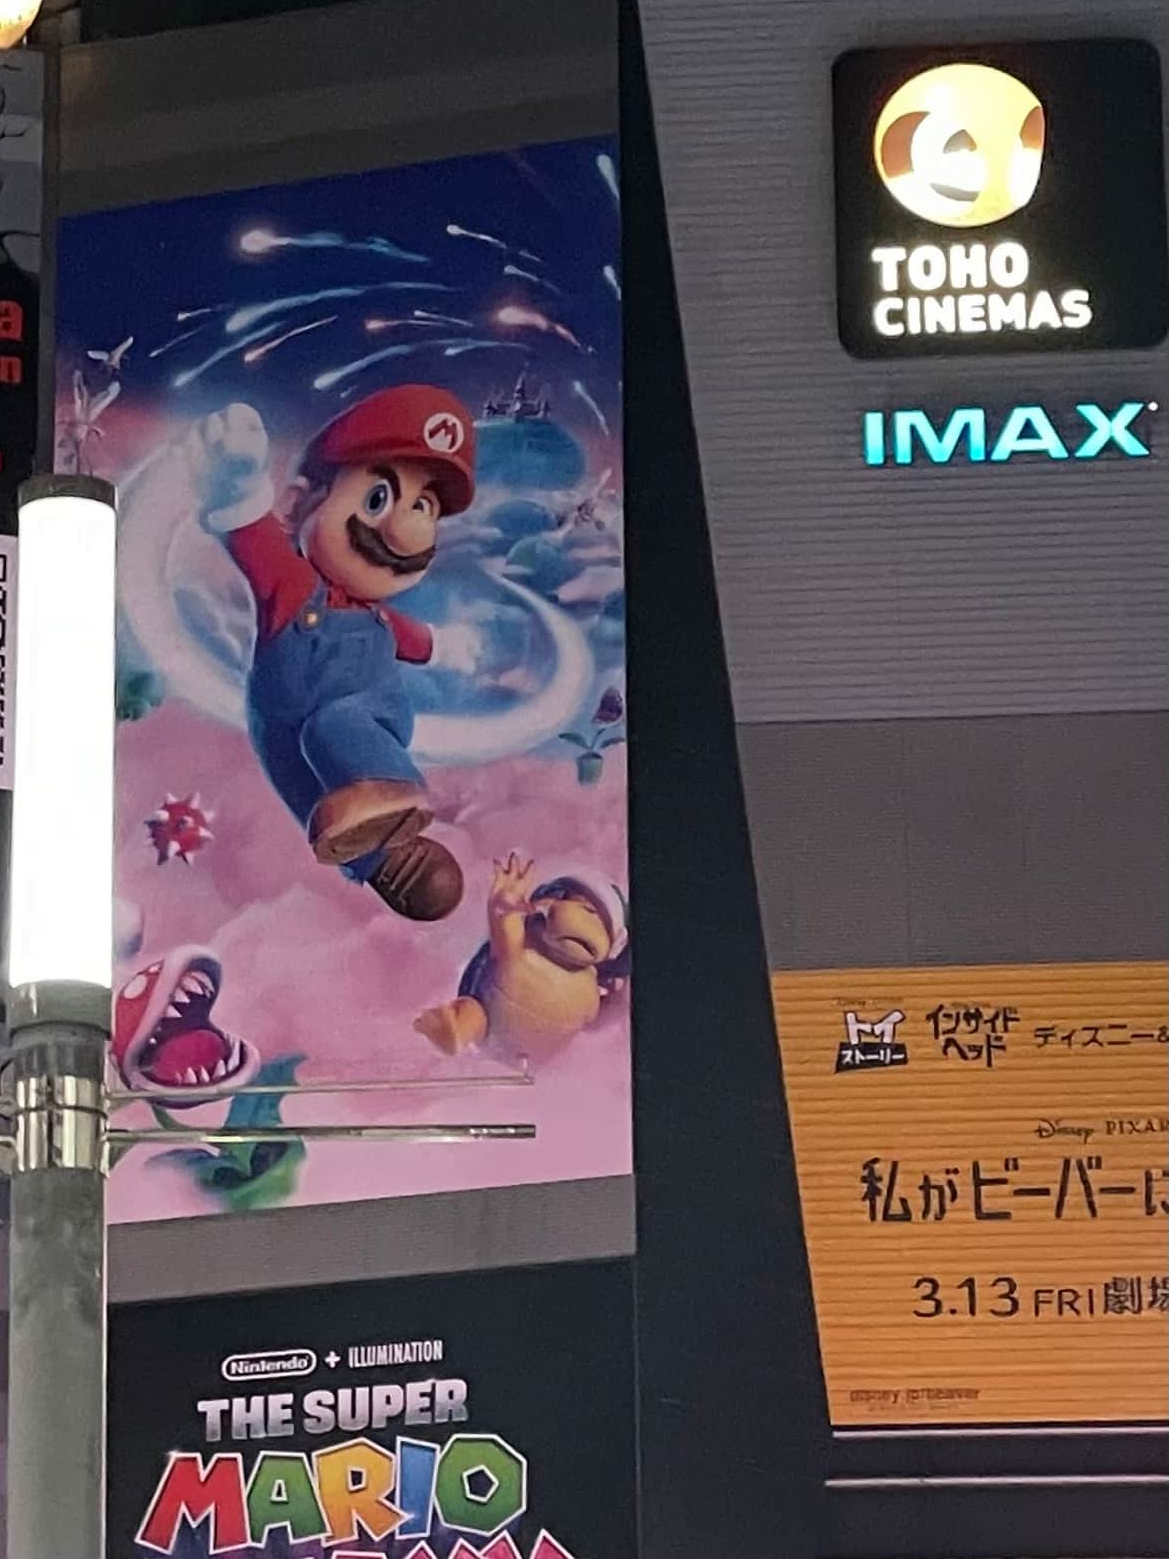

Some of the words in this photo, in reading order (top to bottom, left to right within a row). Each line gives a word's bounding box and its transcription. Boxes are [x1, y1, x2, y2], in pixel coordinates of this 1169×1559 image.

[871, 242, 1029, 292] TOHO
[872, 290, 1094, 338] CINEMAS
[863, 402, 1149, 466] IMAX
[844, 1008, 907, 1045] トイ
[926, 1003, 1021, 1040] インサイド
[841, 1047, 906, 1065] ストーリー
[942, 1033, 1007, 1068] ヘッド
[912, 1276, 1021, 1319] 3.13
[1033, 1287, 1096, 1318] FRI
[230, 1355, 310, 1375] Nintendo
[348, 1339, 444, 1369] ILLUMINATION
[197, 1393, 295, 1442] THE
[303, 1378, 469, 1435] SUPER
[134, 1433, 528, 1555] MARIO
